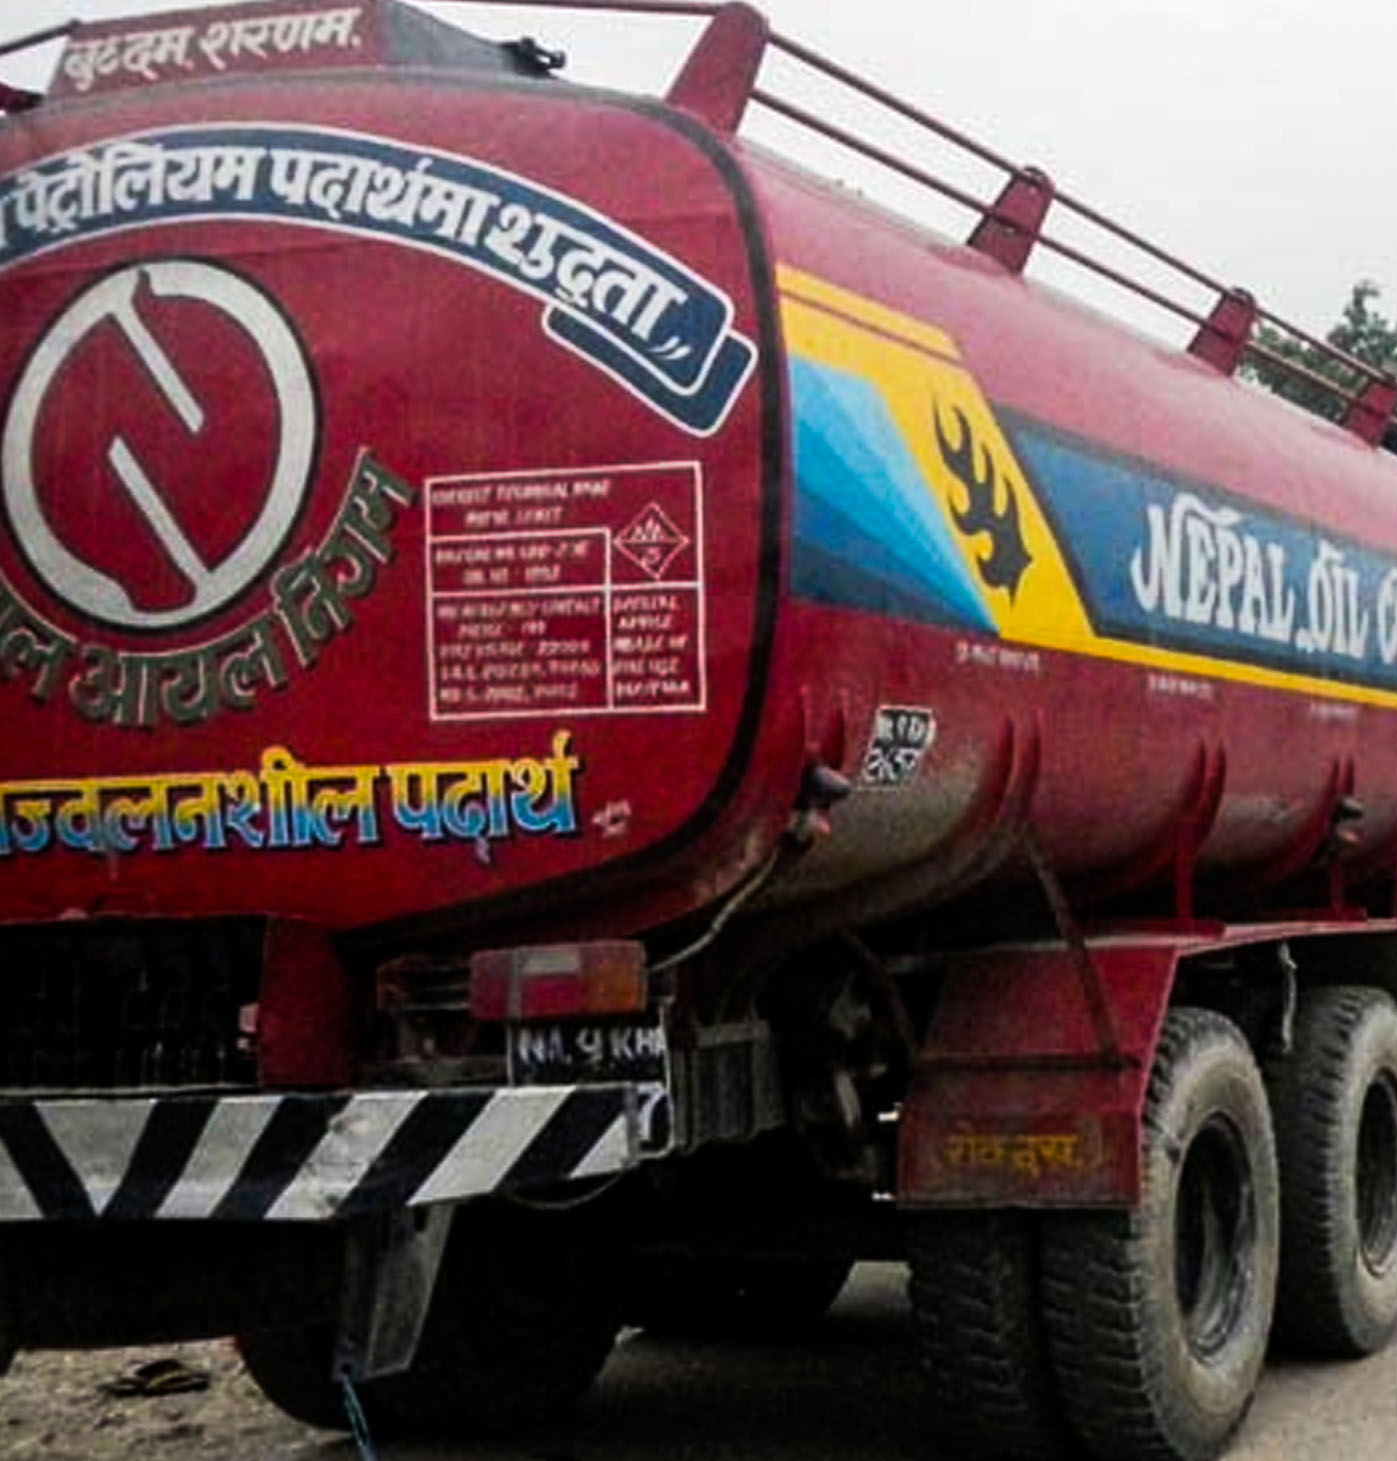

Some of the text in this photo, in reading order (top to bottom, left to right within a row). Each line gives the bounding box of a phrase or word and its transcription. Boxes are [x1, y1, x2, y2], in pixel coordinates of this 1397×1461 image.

[1130, 493, 1296, 642] NEPAL
[1297, 538, 1369, 659] OIL
[386, 729, 580, 864] पदार्थ
